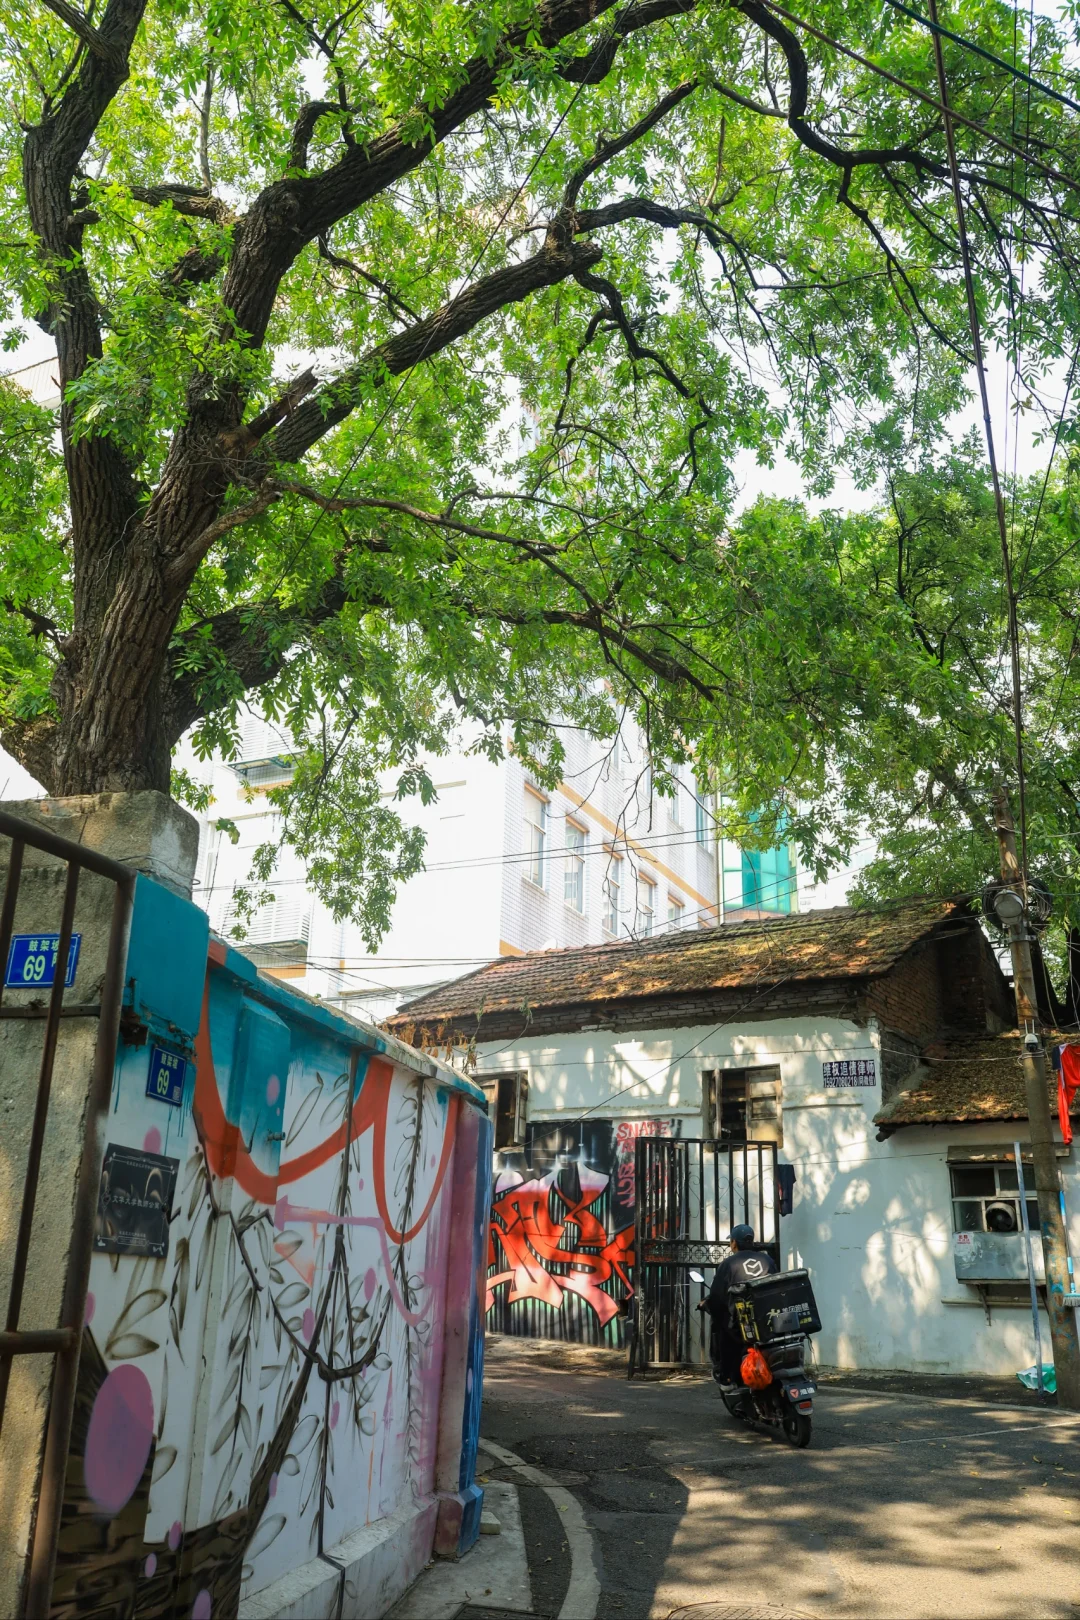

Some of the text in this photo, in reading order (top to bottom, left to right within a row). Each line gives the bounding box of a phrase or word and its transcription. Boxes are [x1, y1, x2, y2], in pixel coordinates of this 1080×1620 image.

[23, 955, 46, 981] 69
[823, 1061, 875, 1076] 维权追债律师
[156, 1068, 170, 1096] 69
